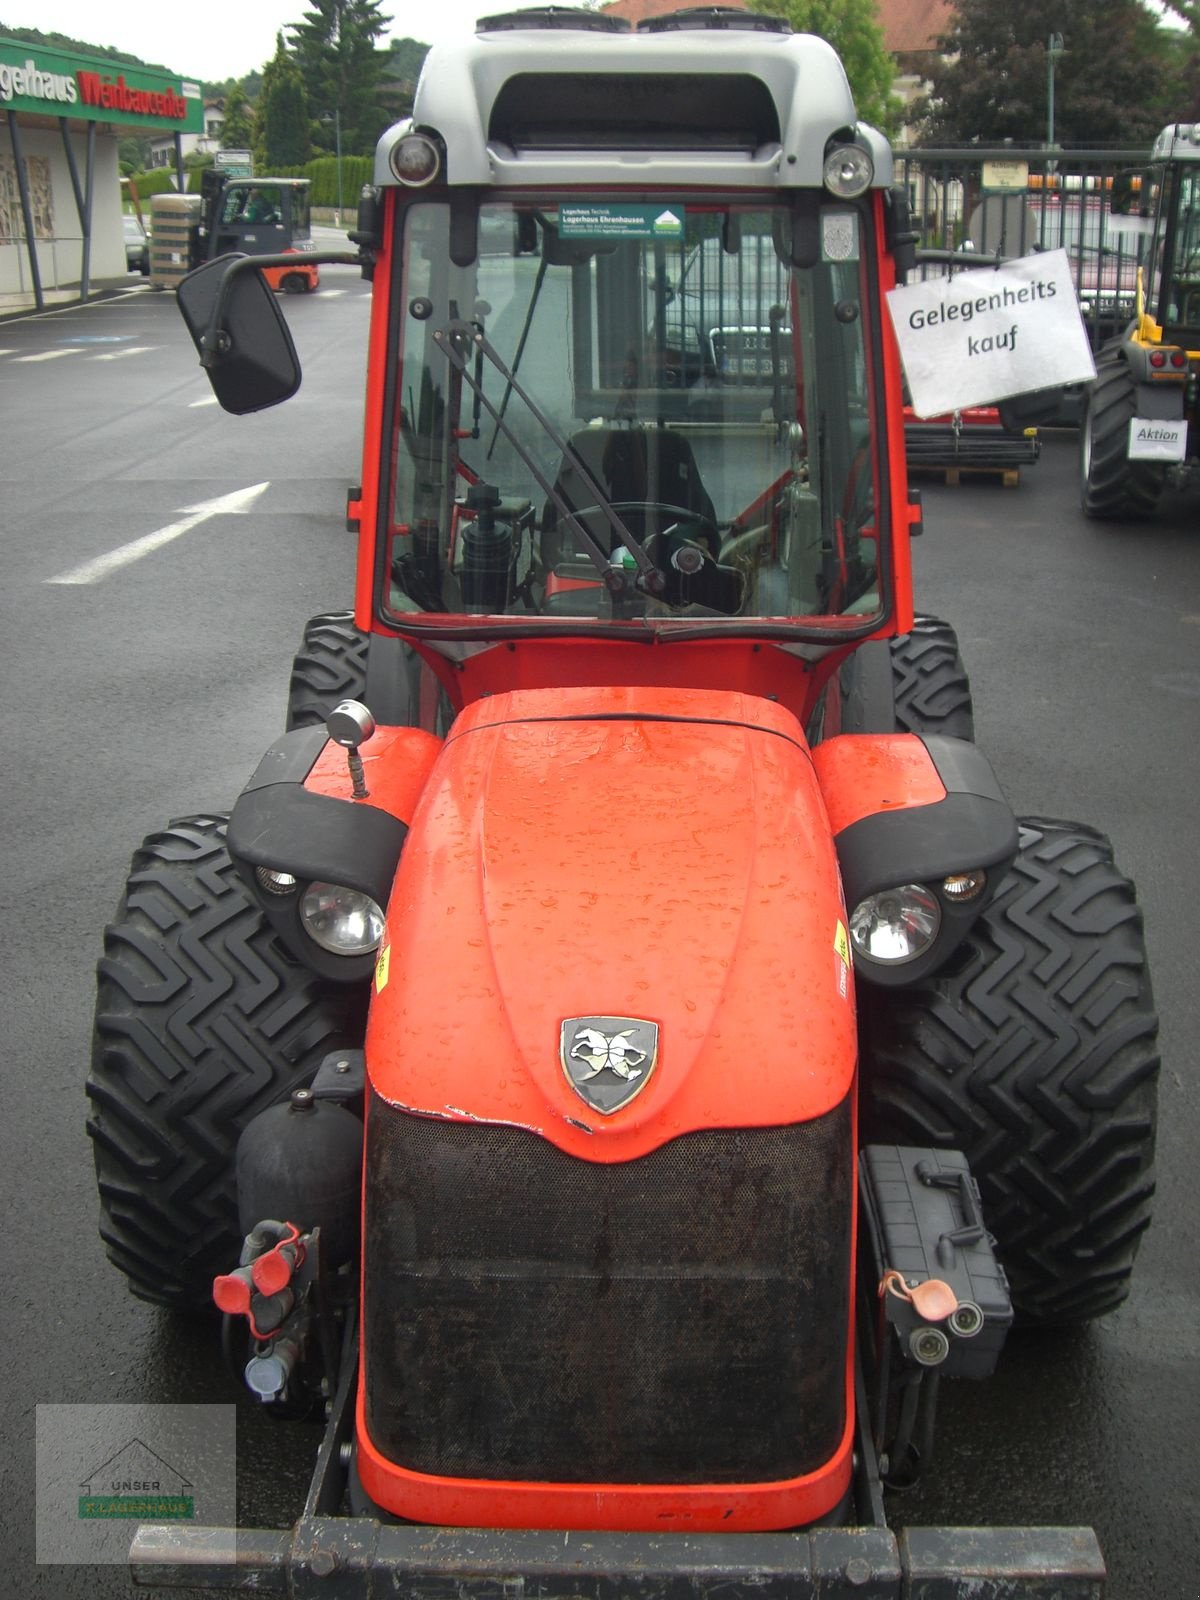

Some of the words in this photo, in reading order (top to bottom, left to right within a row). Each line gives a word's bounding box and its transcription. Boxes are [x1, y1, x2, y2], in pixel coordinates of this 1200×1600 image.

[562, 215, 599, 224] Lagerhaus
[600, 215, 645, 223] Ehrenhausen
[909, 280, 1057, 330] Gelegenheits
[968, 324, 1018, 356] kauf
[1137, 427, 1179, 441] Aktion
